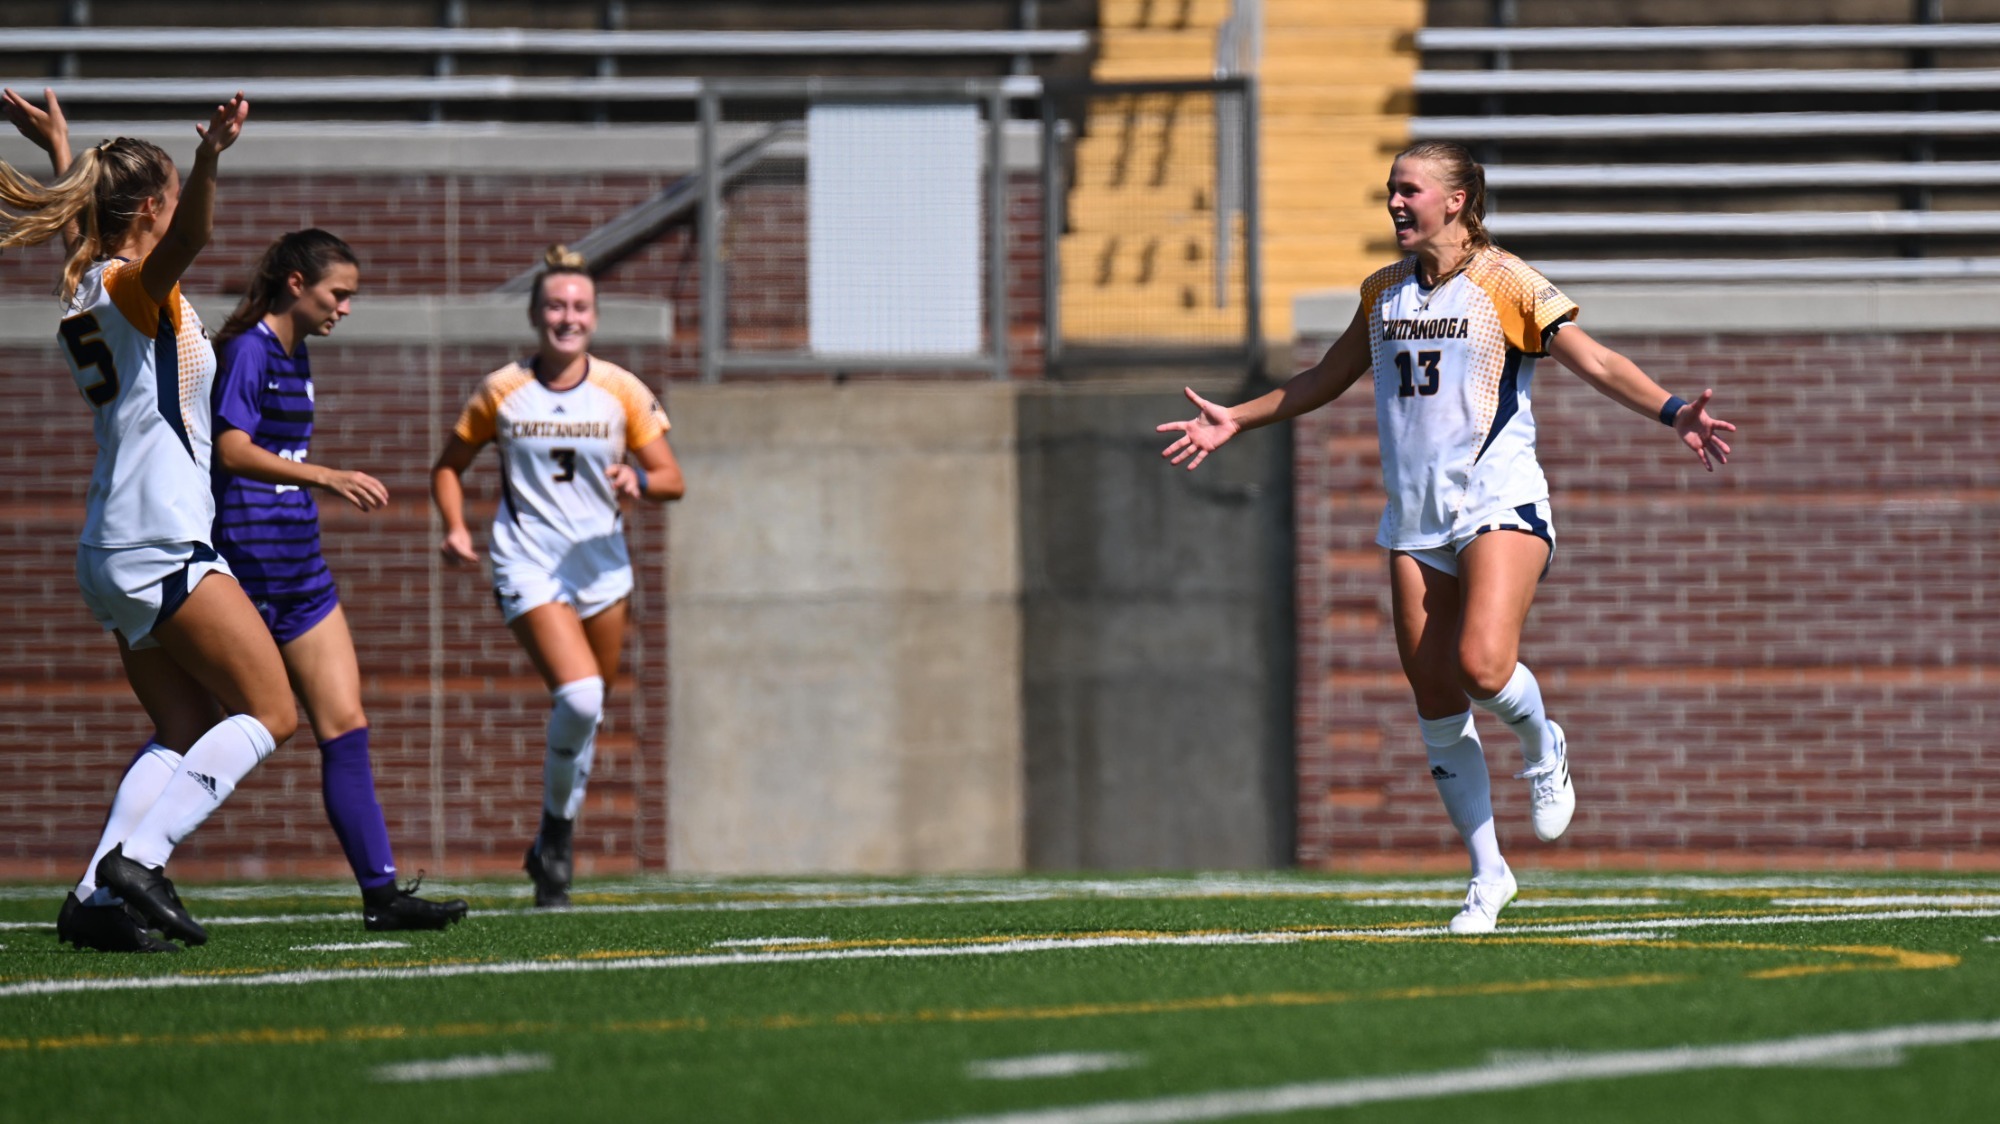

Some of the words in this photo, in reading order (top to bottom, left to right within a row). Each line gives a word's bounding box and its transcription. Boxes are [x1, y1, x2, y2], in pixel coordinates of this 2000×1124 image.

[1382, 317, 1469, 341] CHATTANOOGA
[60, 309, 120, 408] 5
[1393, 350, 1442, 397] 13
[549, 447, 576, 482] 3
